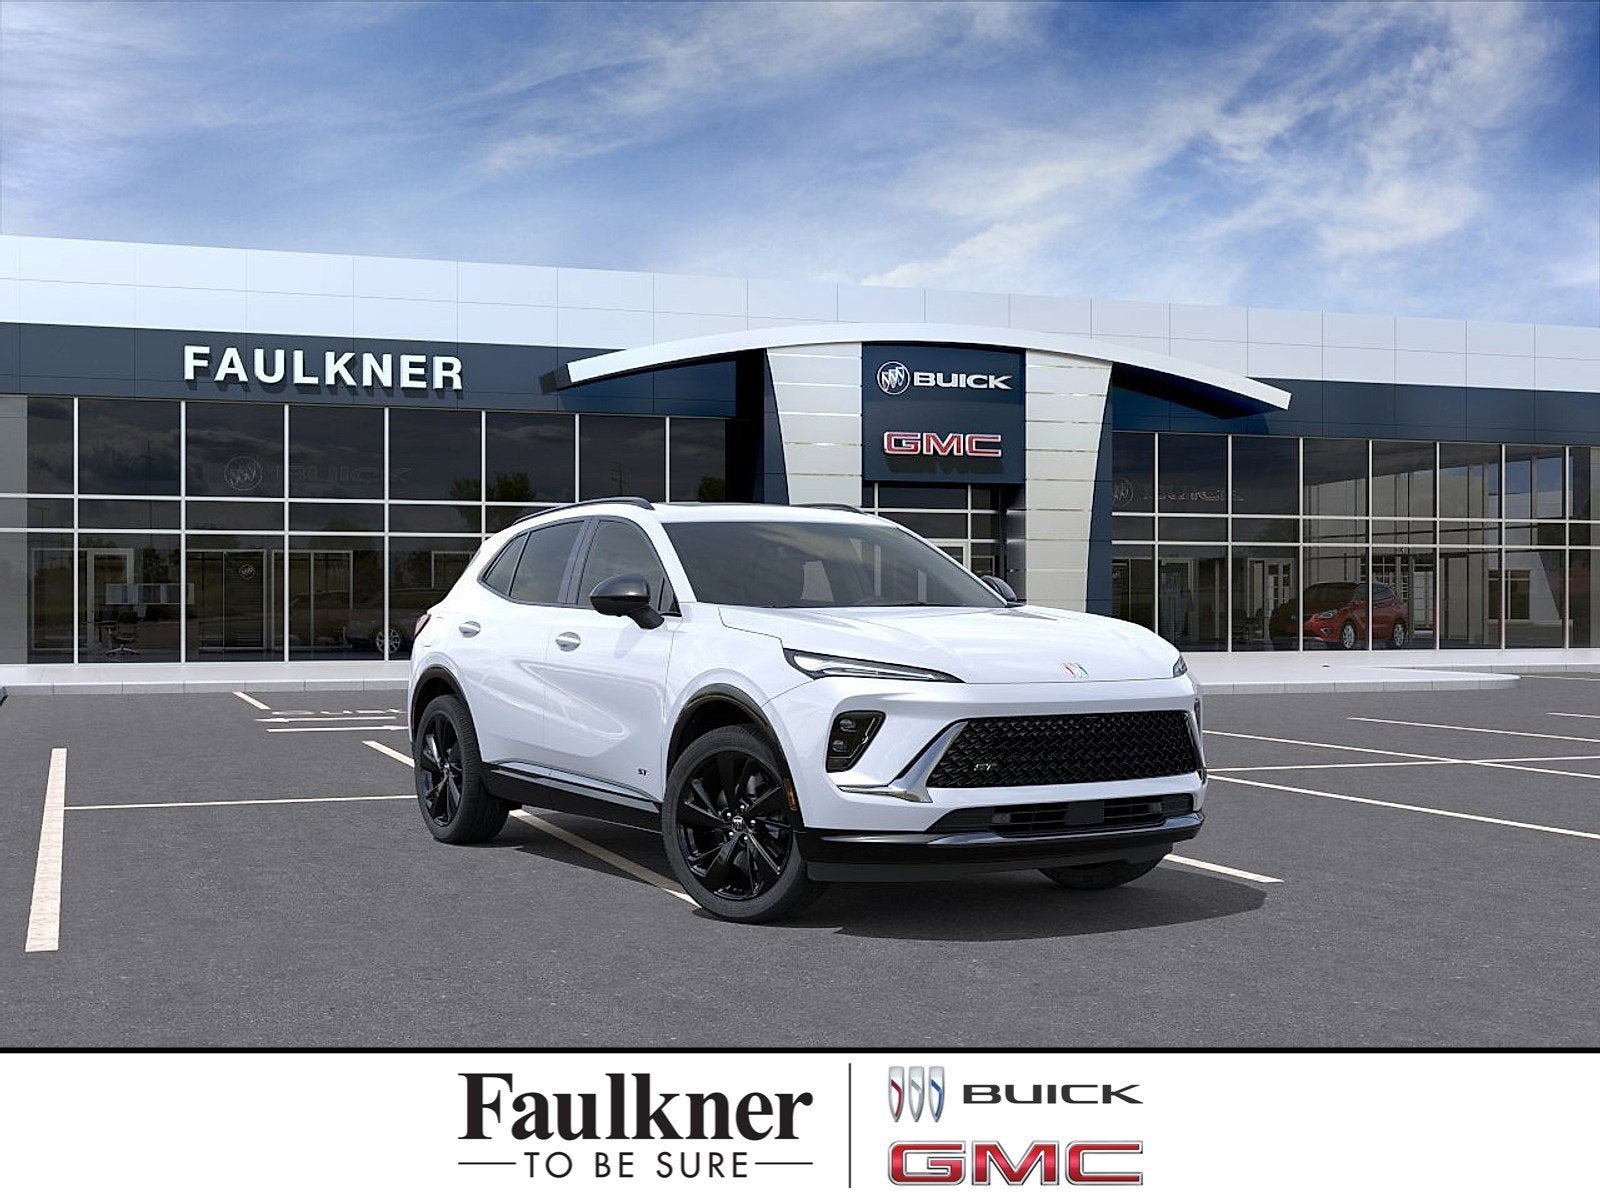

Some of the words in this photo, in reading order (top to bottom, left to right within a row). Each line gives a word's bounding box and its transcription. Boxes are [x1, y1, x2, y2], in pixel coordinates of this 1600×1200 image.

[184, 344, 463, 390] FAULKNER
[913, 371, 1013, 390] BUICK
[883, 431, 1003, 457] GMC
